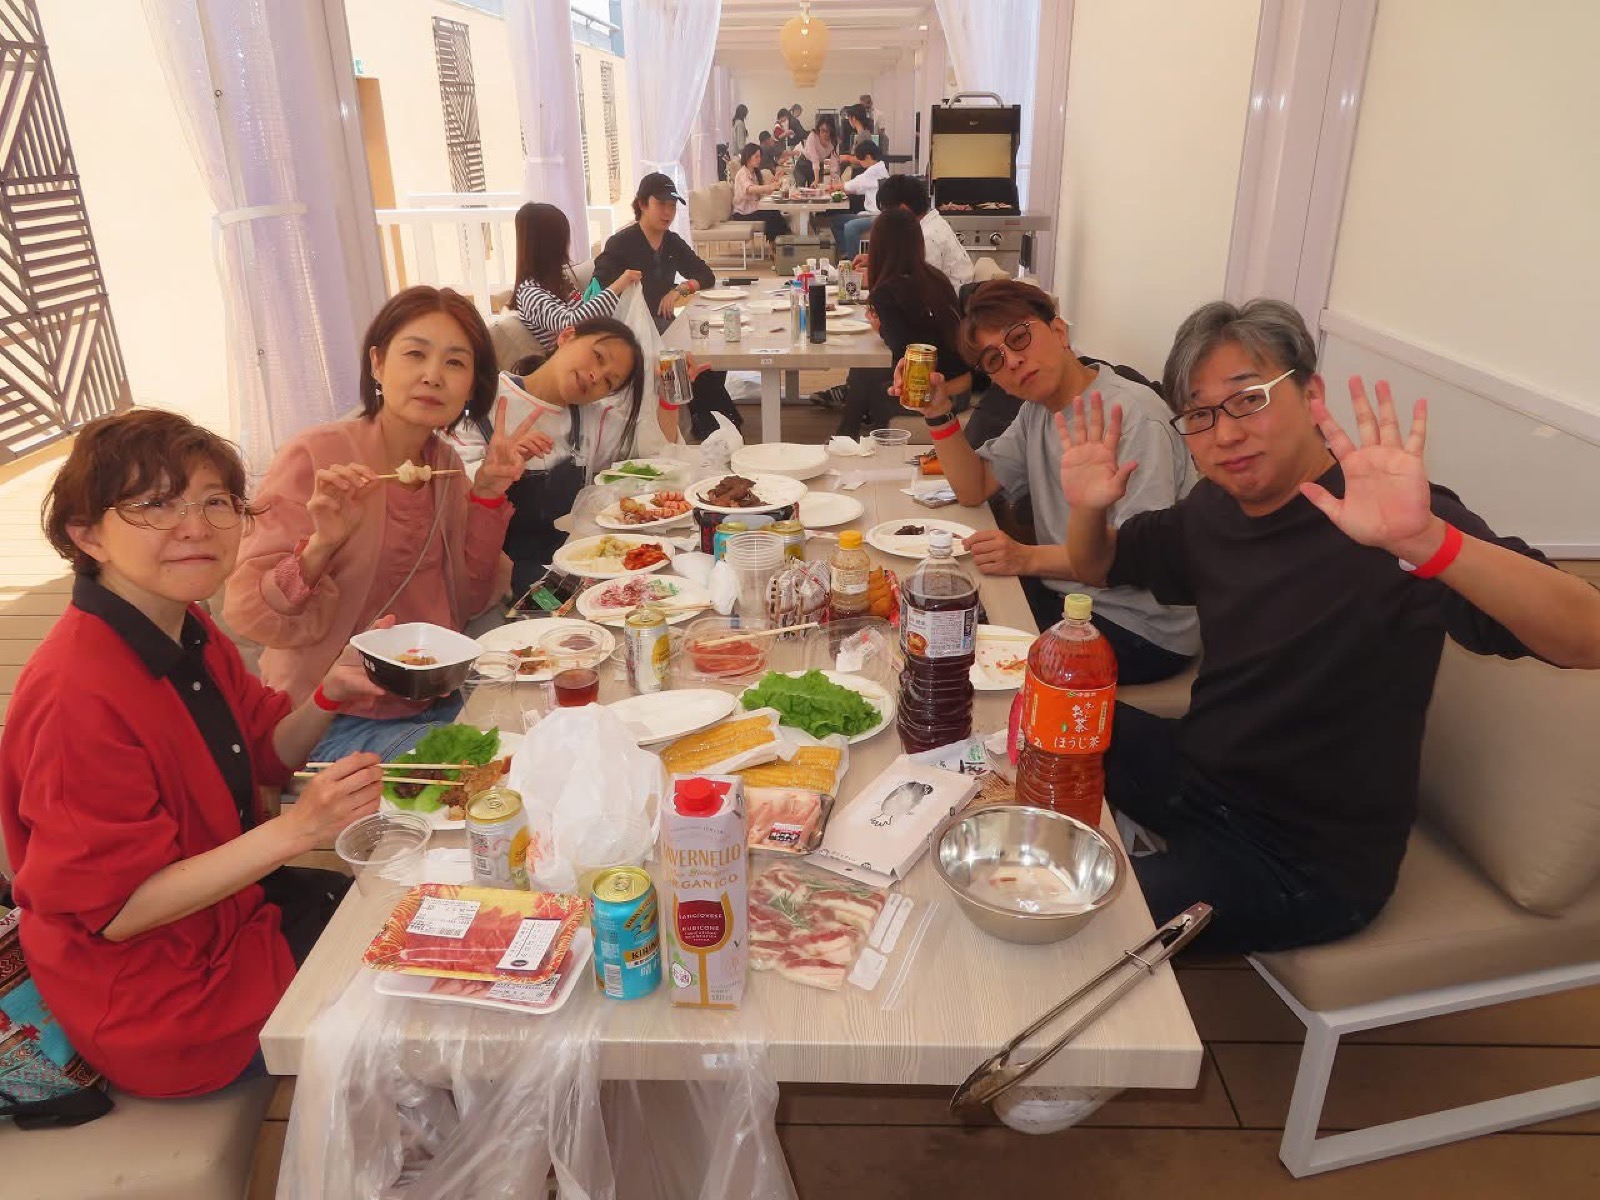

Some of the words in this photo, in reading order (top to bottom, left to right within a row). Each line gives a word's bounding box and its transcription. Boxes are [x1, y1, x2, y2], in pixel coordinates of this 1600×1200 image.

[1054, 736, 1100, 749] ほうじ茶
[671, 873, 738, 889] RGANICO
